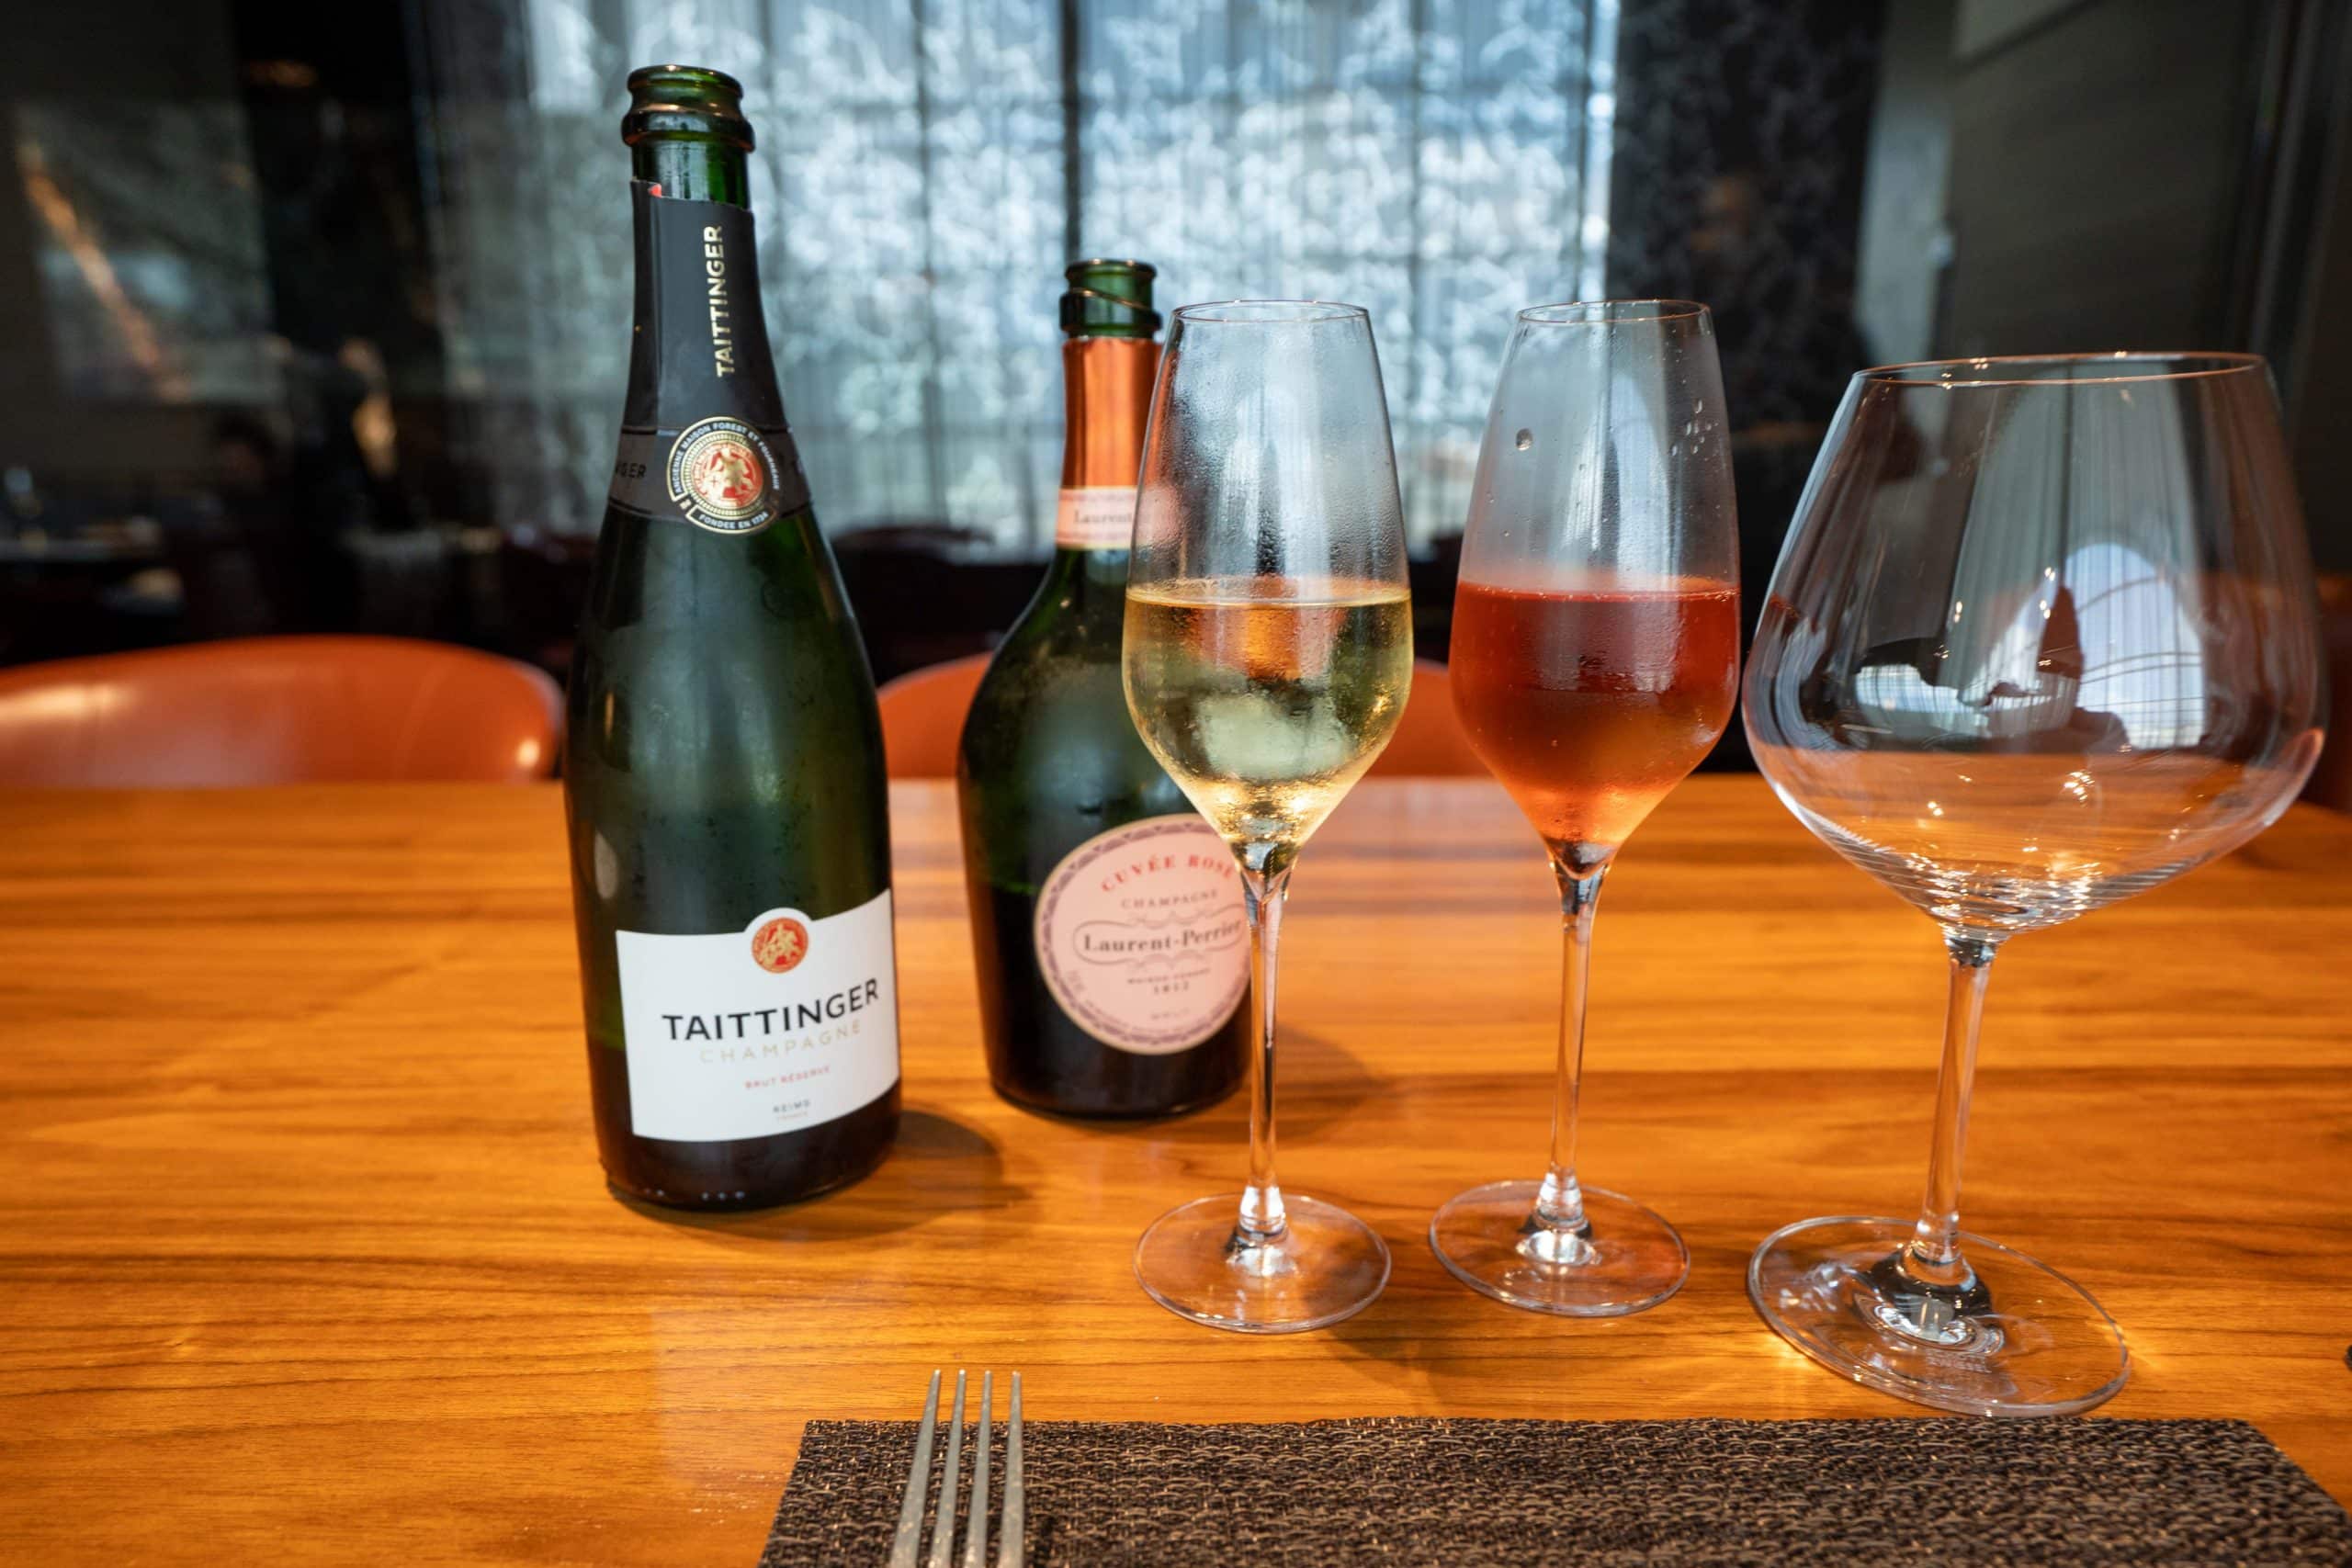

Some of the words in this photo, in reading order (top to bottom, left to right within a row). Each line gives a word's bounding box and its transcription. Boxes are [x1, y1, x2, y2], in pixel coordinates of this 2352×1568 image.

[703, 226, 735, 378] TAITTINGER
[672, 450, 684, 493] ANCIENNE
[681, 424, 711, 449] MAISON
[713, 423, 747, 434] FOREST
[748, 431, 760, 441] ET
[1121, 888, 1217, 908] CHAMPAGNE
[662, 978, 879, 1040] TAITTINGER
[700, 1019, 861, 1063] CHAMPAGNE
